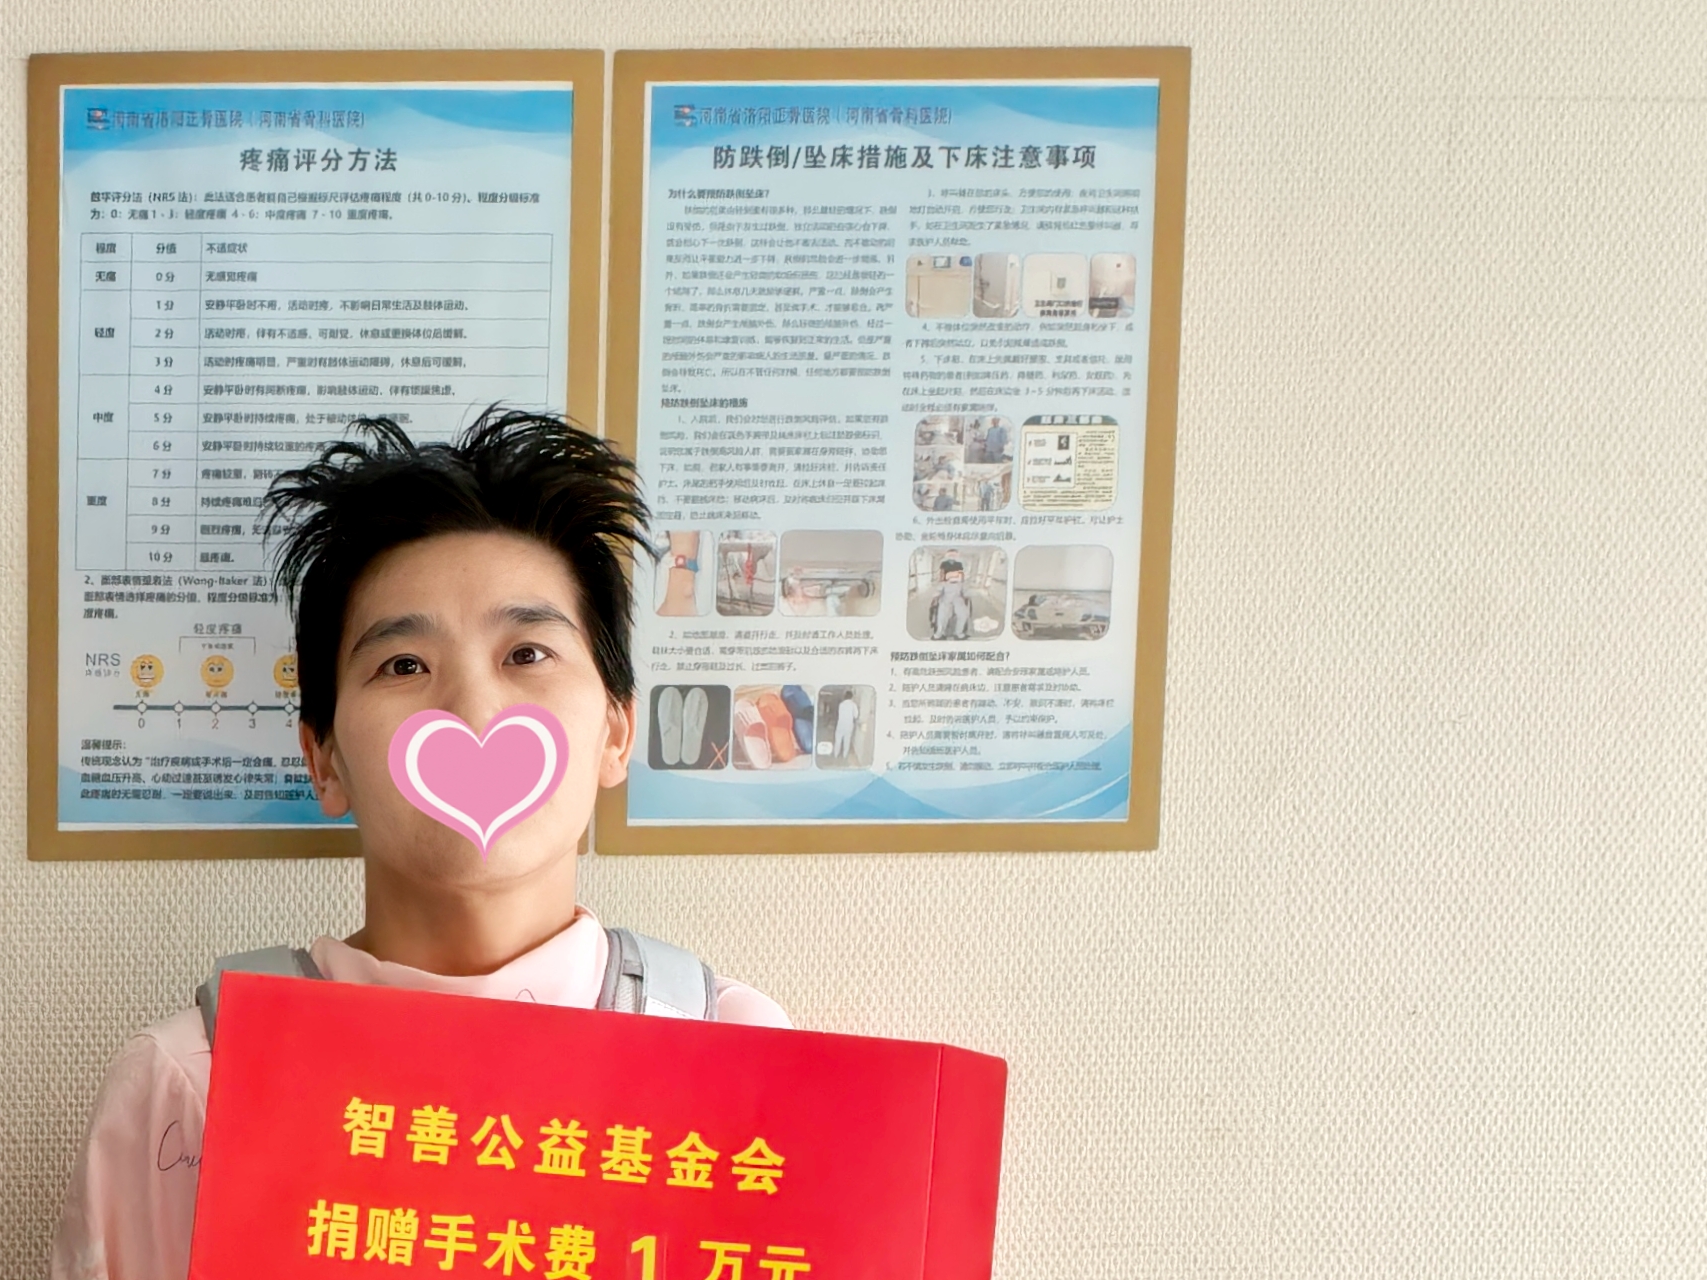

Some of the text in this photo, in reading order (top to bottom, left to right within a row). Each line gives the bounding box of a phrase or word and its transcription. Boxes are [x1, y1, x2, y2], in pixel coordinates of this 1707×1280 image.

[240, 147, 398, 172] 疼痛评分方法
[713, 145, 1096, 169] 防跌倒/坠床措施及下床注意事项
[86, 653, 121, 666] NRS
[138, 718, 145, 729] 0
[176, 718, 182, 729] 1
[211, 718, 219, 729] 2
[343, 1096, 785, 1195] 智善公益基金会
